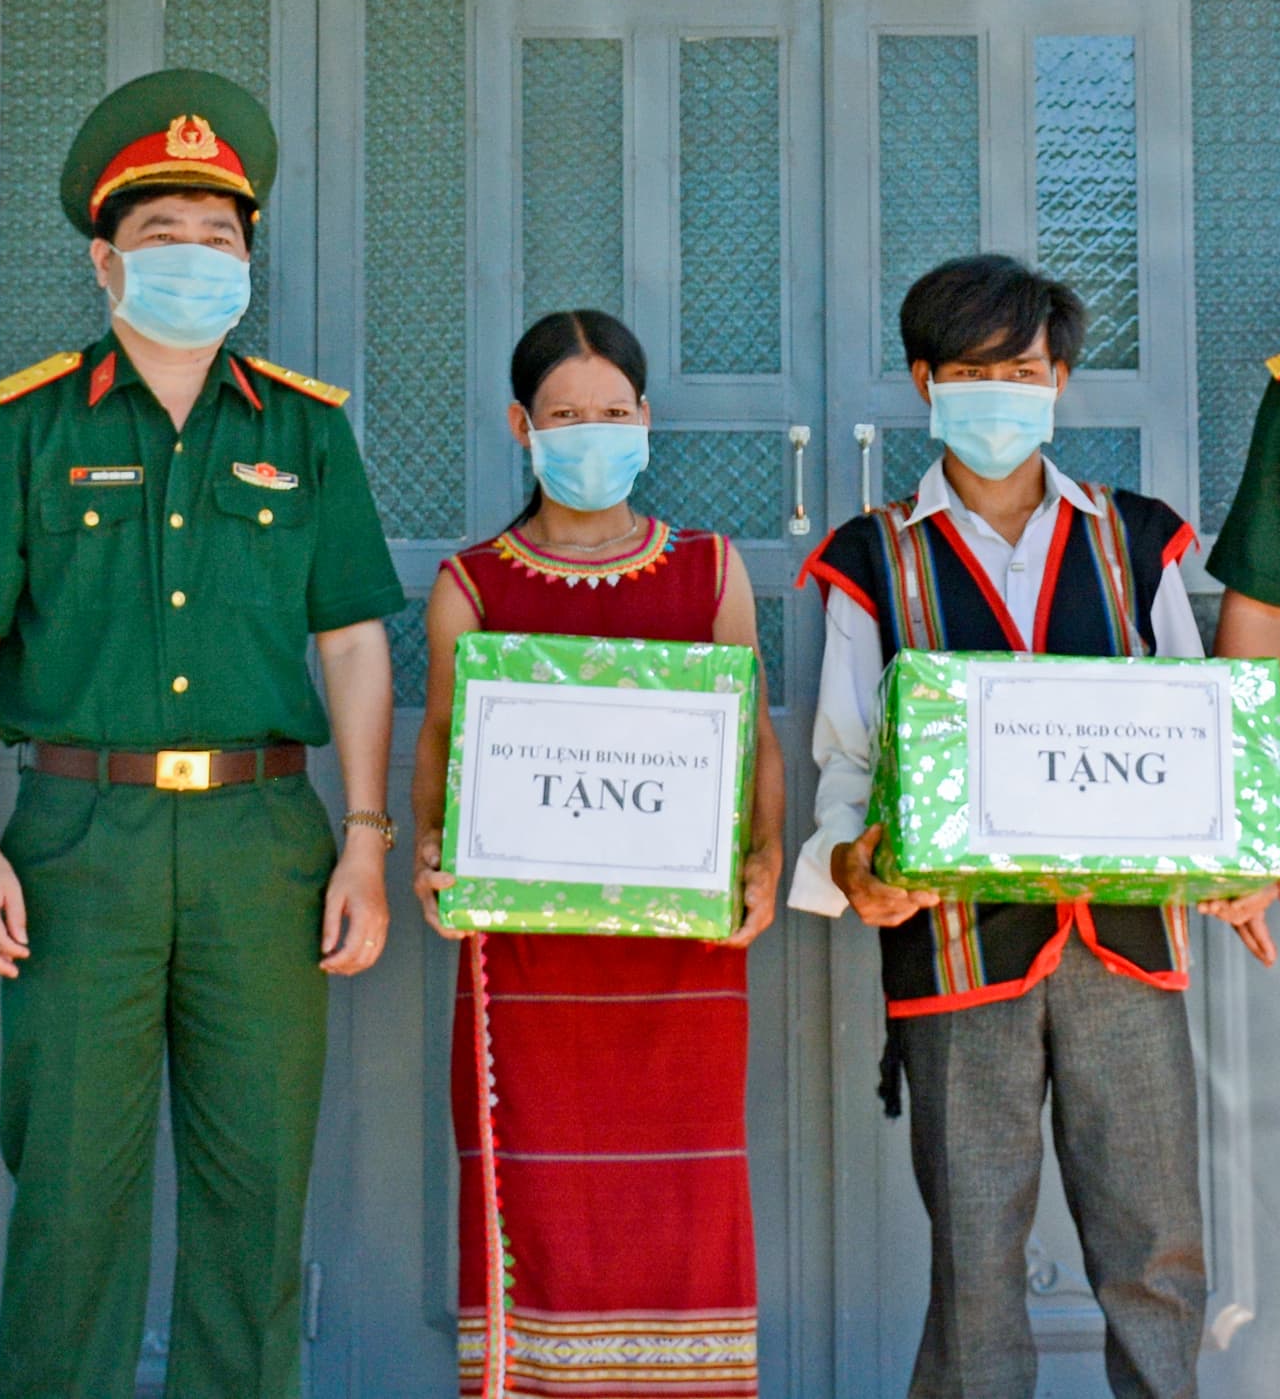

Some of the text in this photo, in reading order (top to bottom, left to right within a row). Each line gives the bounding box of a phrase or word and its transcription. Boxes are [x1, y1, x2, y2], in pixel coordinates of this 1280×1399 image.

[1113, 721, 1161, 739] CÔNG
[1165, 726, 1186, 740] TY
[1191, 727, 1208, 741] 78
[517, 744, 543, 760] TƯ
[596, 750, 636, 766] BINH
[693, 756, 710, 769] 15
[1038, 745, 1168, 793] TẶNG
[533, 770, 666, 819] TẶNG
